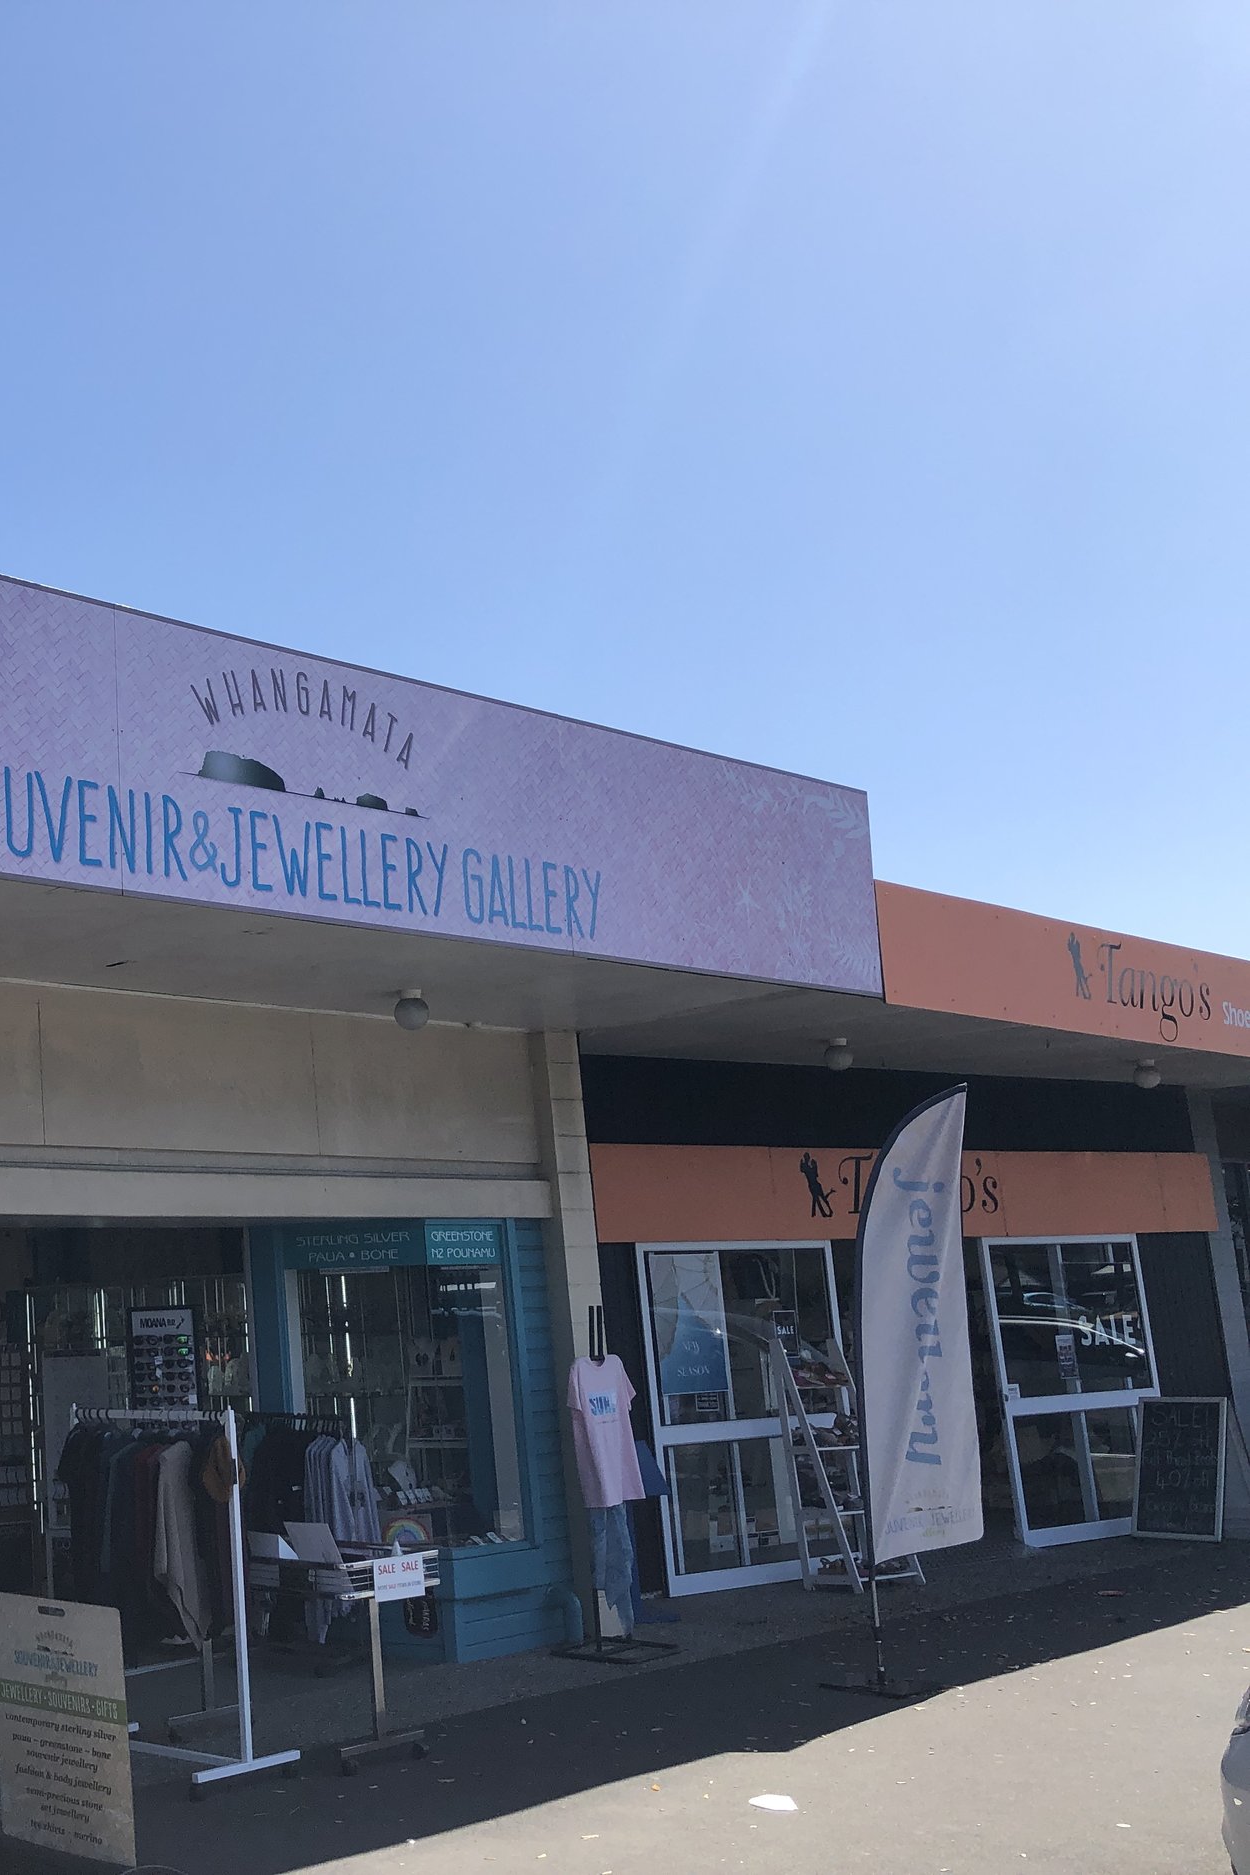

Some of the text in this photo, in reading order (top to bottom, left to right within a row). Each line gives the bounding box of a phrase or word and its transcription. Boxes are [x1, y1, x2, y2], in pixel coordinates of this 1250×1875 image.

[190, 668, 416, 771] WHANGAMATA
[462, 847, 602, 940] GALLERY
[1099, 942, 1212, 1042] Tango's
[296, 1231, 410, 1247] STERLING SILVER
[431, 1230, 494, 1242] GREENSTONE
[308, 1249, 398, 1263] PAUA BONE
[447, 1247, 496, 1259] POUNAMU
[777, 1325, 794, 1335] SALE
[378, 1560, 419, 1575] SALE SALE
[1, 1682, 118, 1719] JEWELLERY SOUVENIRS GIFTS
[5, 1712, 116, 1741] contemporary sterling silver
[91, 1747, 112, 1760] bone
[61, 1753, 98, 1773] jewellery
[54, 1772, 72, 1786] body
[73, 1776, 112, 1796] jewellery
